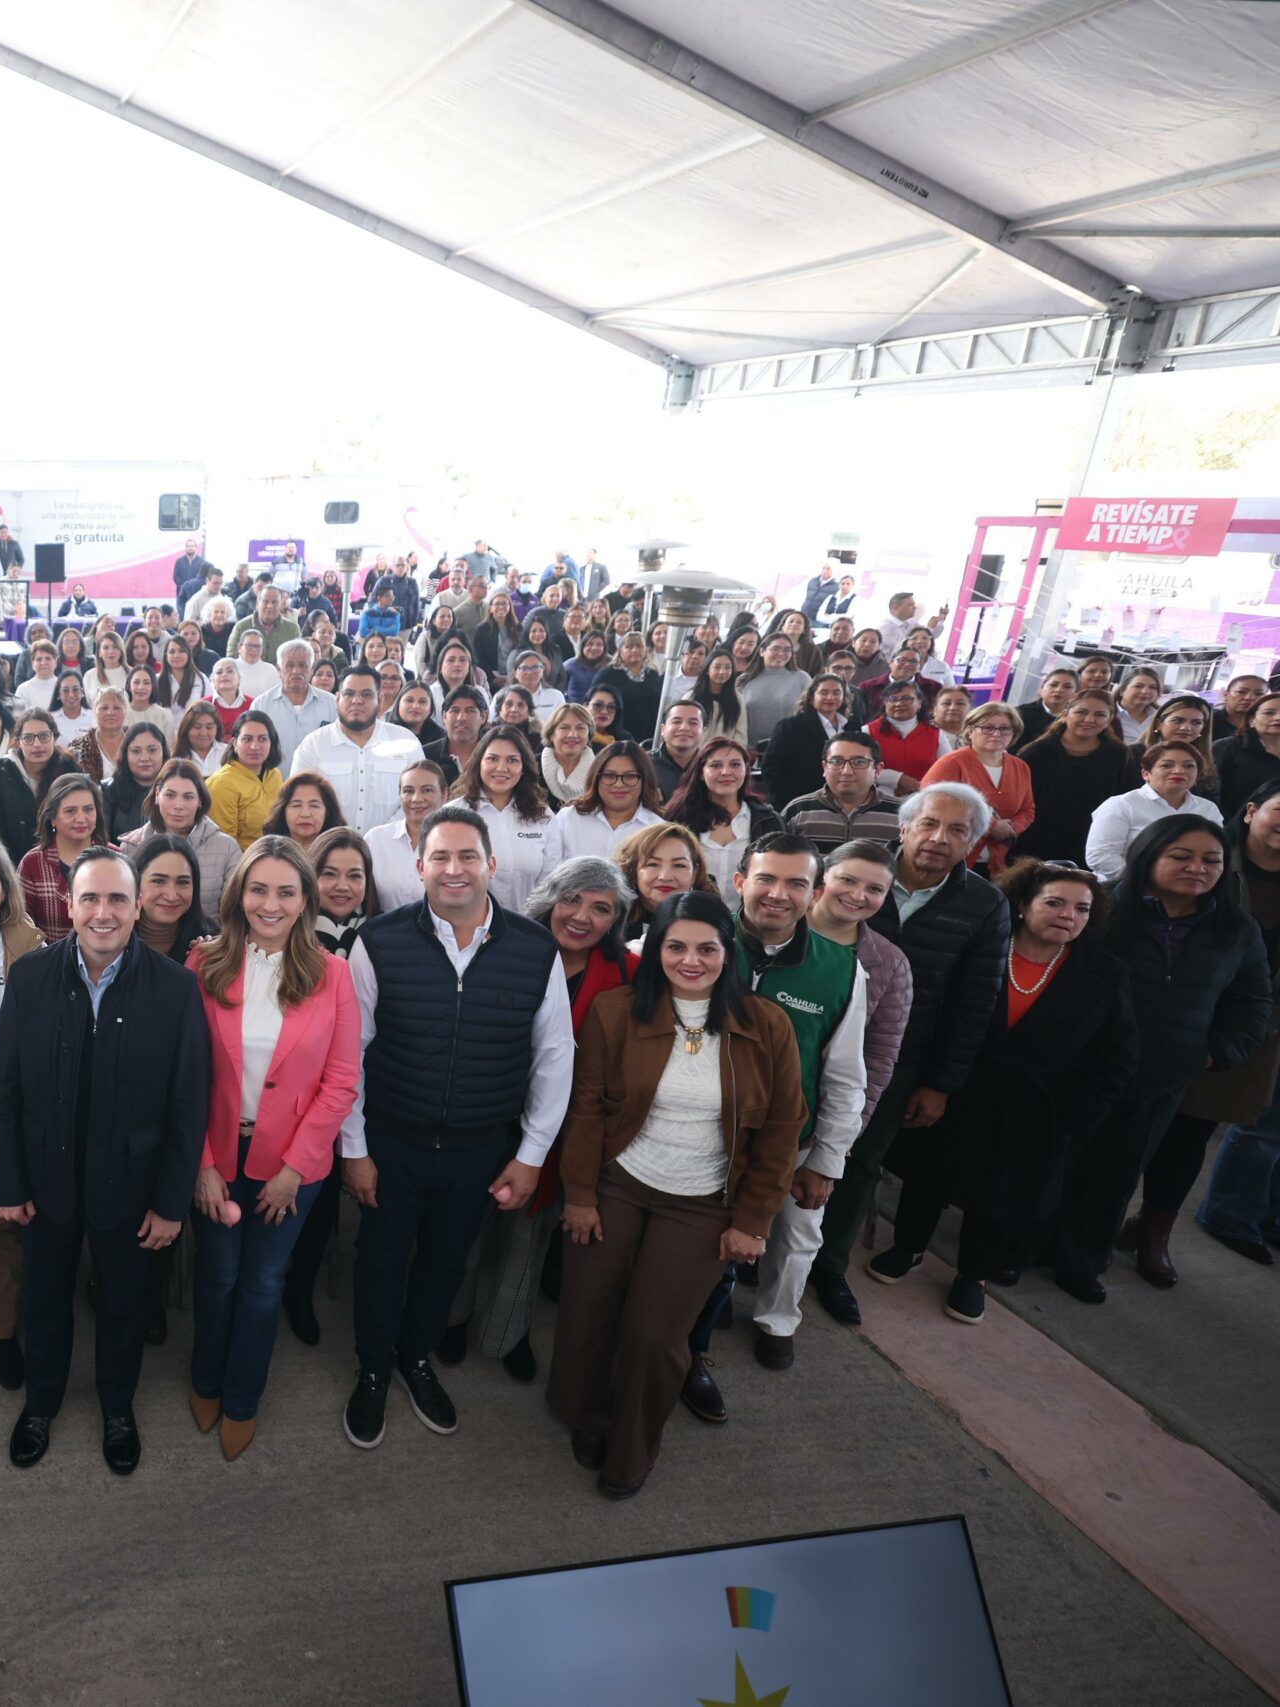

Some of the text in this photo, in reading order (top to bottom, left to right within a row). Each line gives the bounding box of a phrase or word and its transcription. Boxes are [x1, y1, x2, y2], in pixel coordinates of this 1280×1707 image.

[880, 168, 919, 193] EUROTENT
[1091, 500, 1198, 525] REVÍSATE
[55, 532, 125, 545] es gratuita
[1084, 524, 1101, 543] A
[776, 991, 824, 1012] COAHUILA
